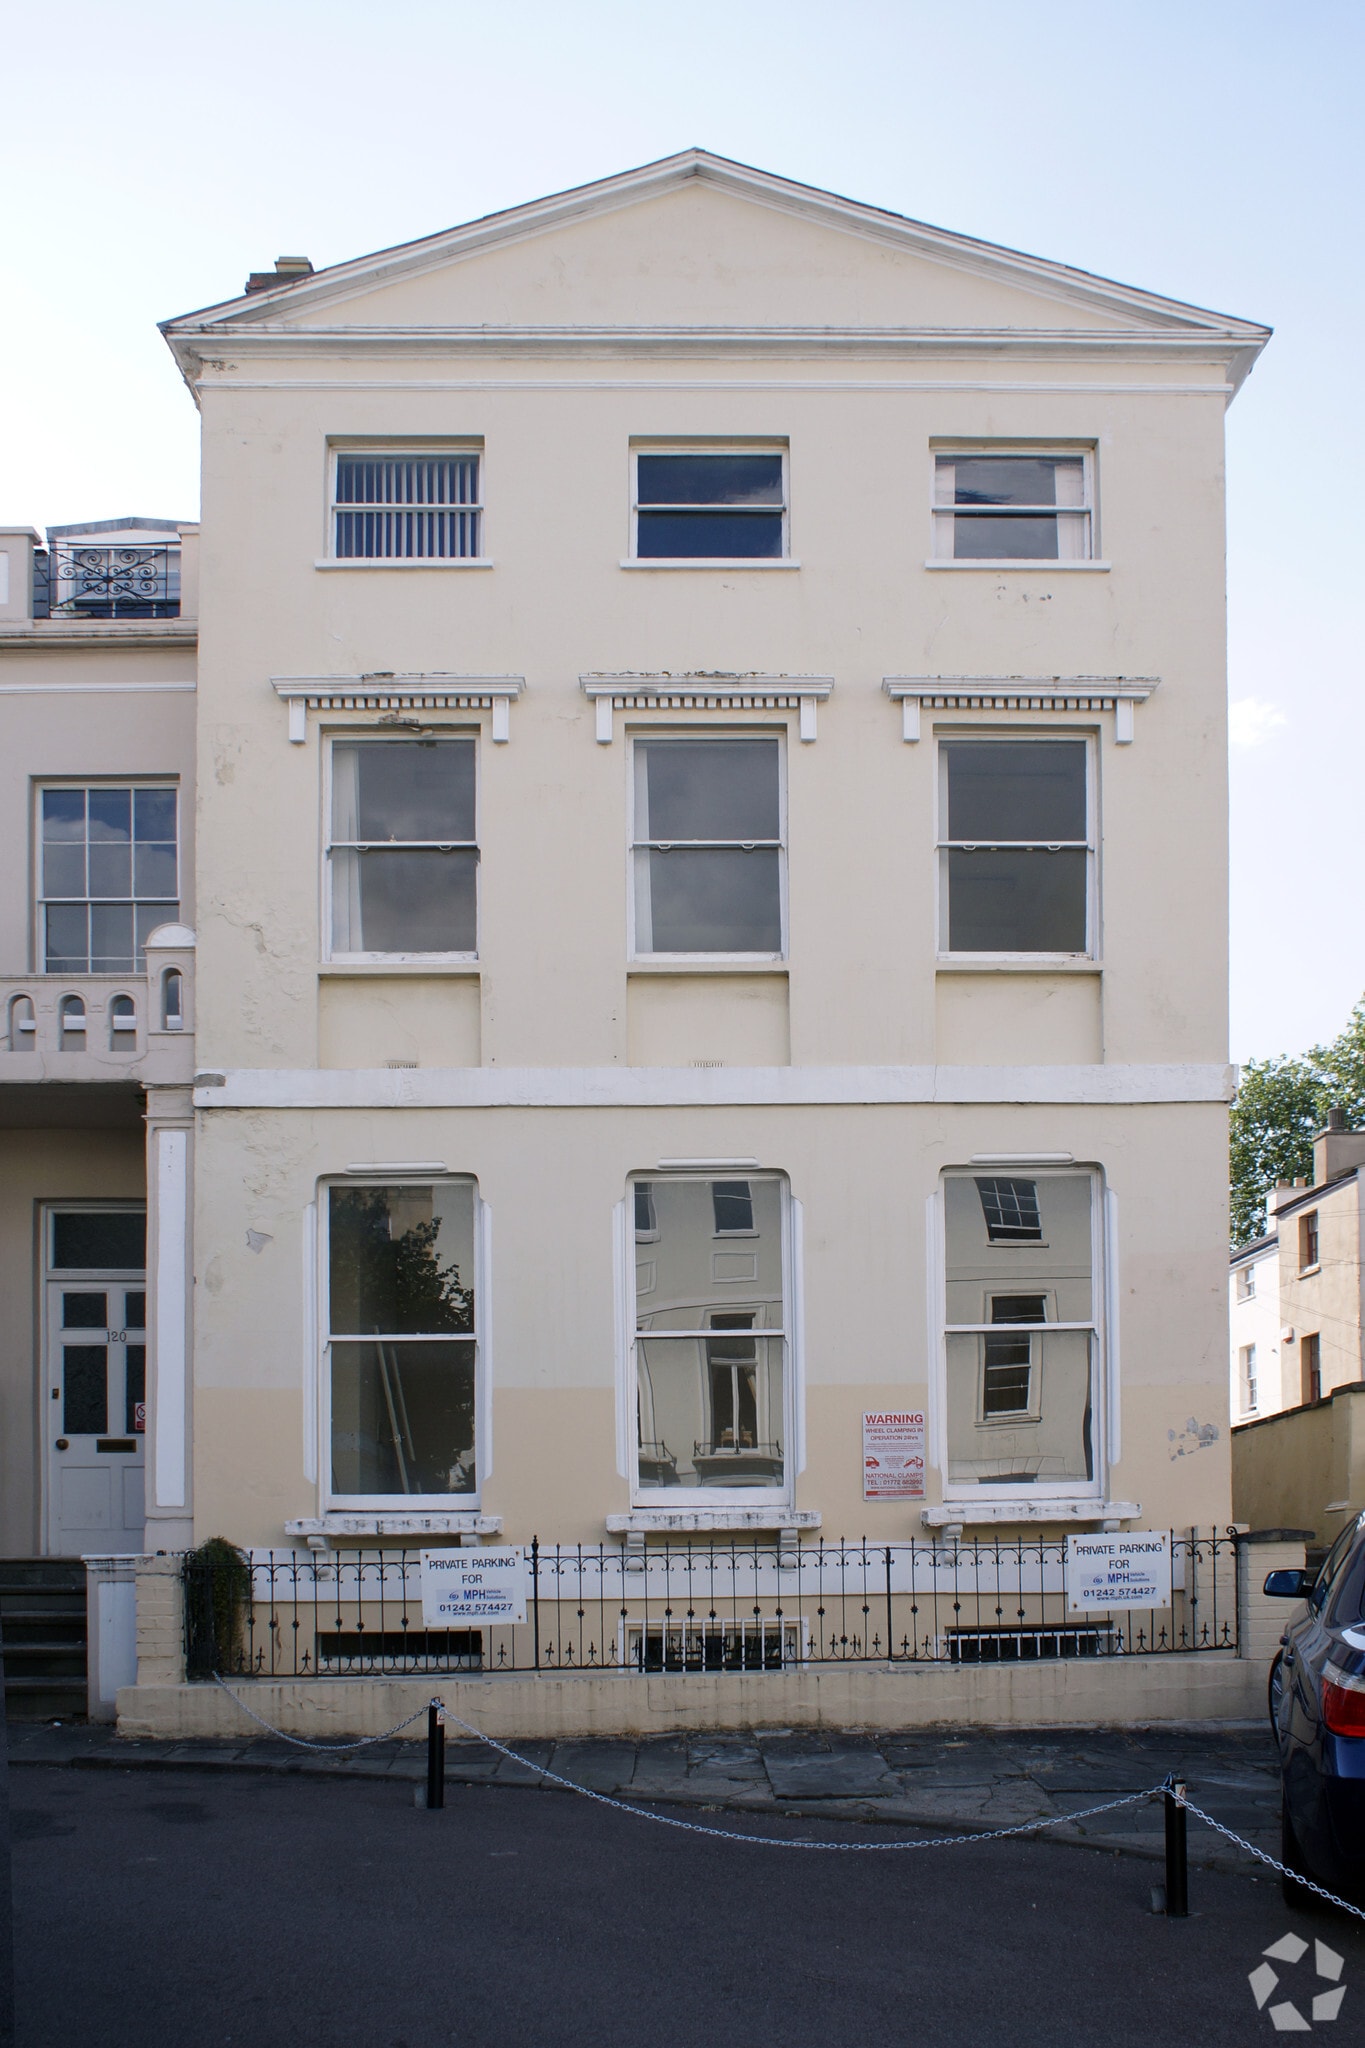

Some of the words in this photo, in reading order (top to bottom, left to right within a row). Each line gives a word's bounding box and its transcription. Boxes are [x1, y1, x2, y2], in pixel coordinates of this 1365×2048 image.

[106, 1331, 127, 1342] 120
[865, 1414, 923, 1424] WARNING
[1076, 1545, 1115, 1555] PRIVATE
[1119, 1543, 1162, 1554] PARKING
[429, 1560, 468, 1570] PRIVATE
[472, 1557, 516, 1568] PARKING
[1109, 1560, 1130, 1569] FOR
[462, 1574, 483, 1584] FOR
[1107, 1573, 1130, 1583] MPH
[463, 1589, 486, 1600] MPH
[1083, 1589, 1115, 1597] 01242
[1118, 1587, 1156, 1596] 574427
[439, 1604, 471, 1612] 01242
[475, 1603, 513, 1611] 574427
